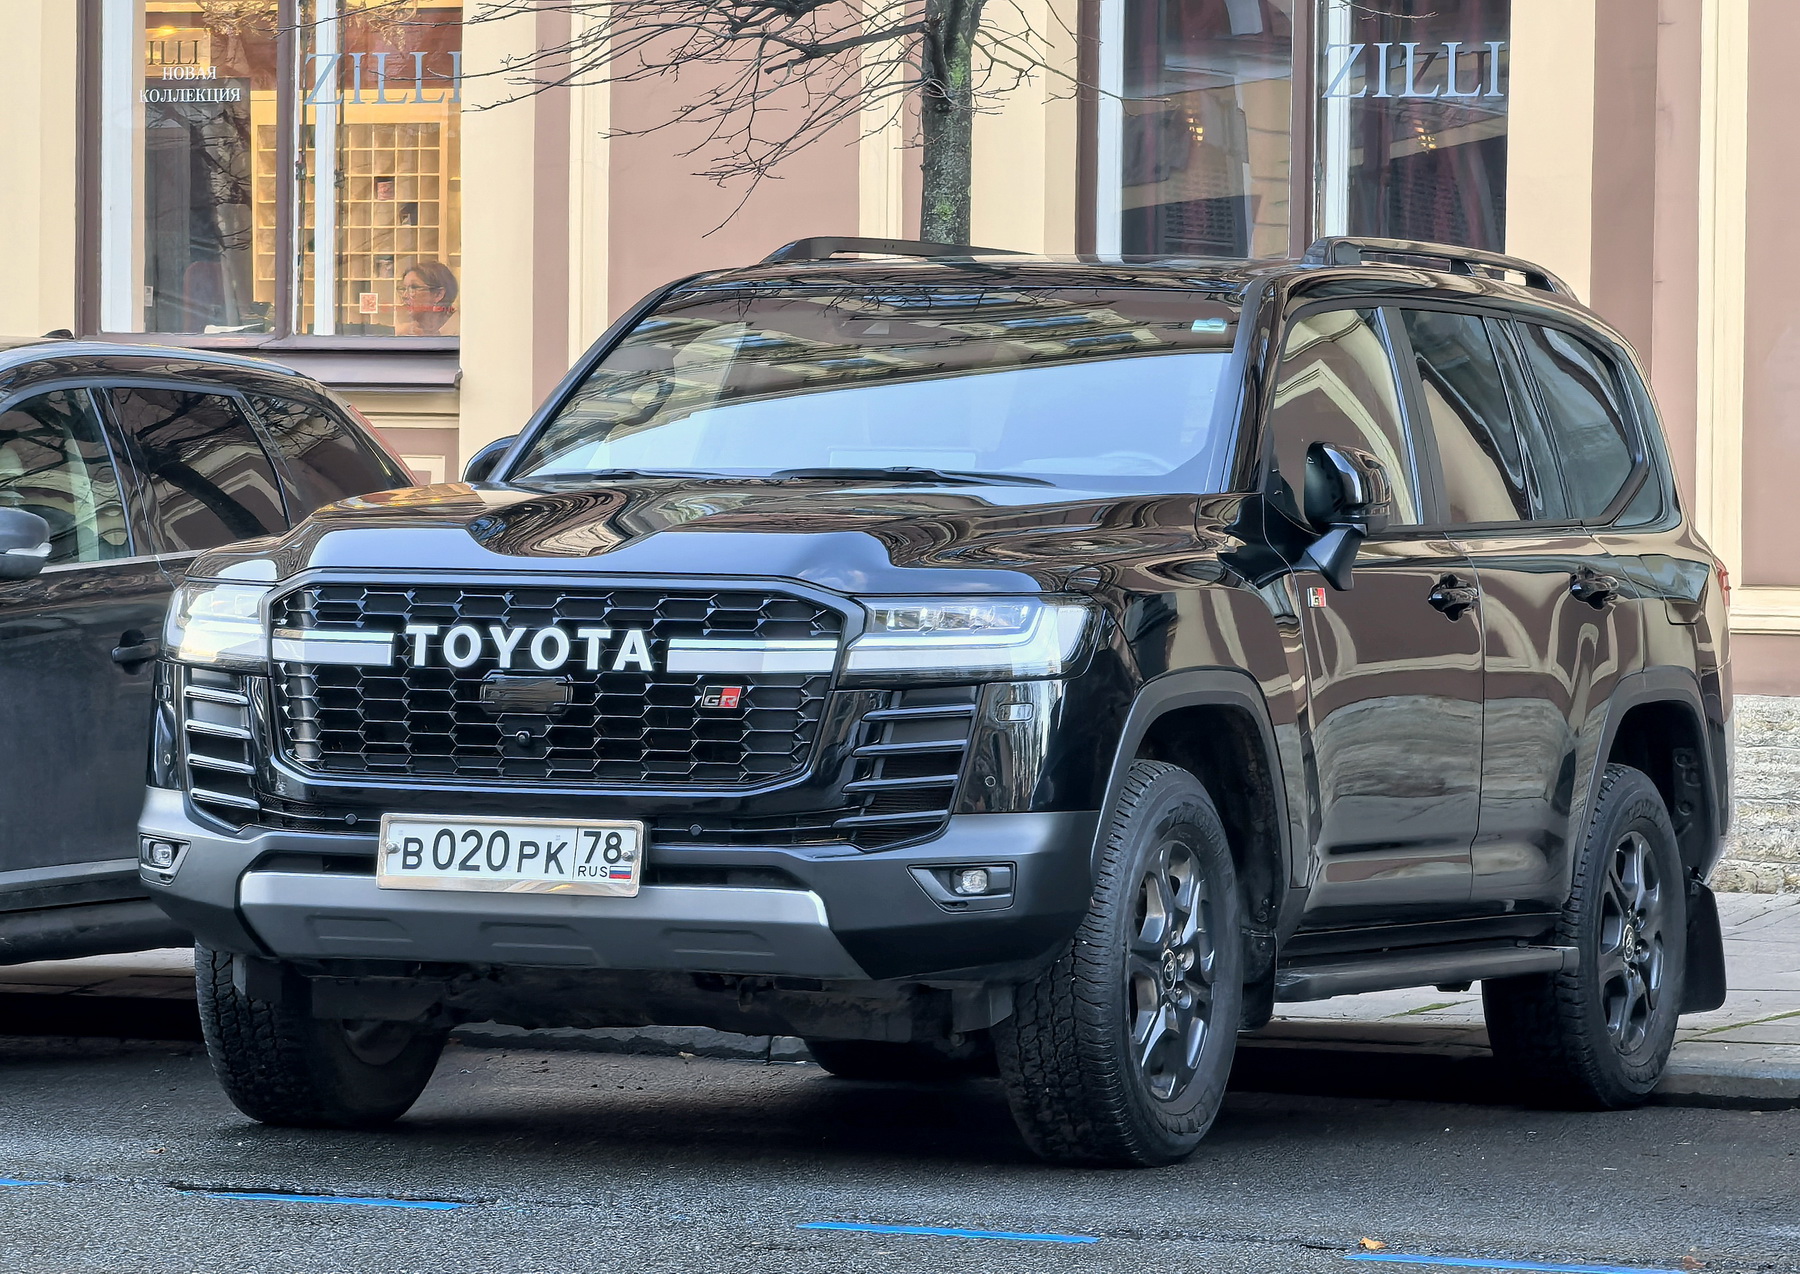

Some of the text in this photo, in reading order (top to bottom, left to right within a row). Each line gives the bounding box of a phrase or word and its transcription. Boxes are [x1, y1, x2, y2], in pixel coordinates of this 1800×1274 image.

[148, 40, 200, 65] ILLI
[162, 66, 217, 80] НОВАЯ
[304, 51, 462, 105] ZILLI
[1322, 41, 1506, 98] ZILLI
[140, 88, 241, 103] КОЛЛЕКЦИЯ
[406, 625, 653, 671] TOYOTA
[583, 831, 622, 865] 78
[577, 866, 608, 878] RUS
